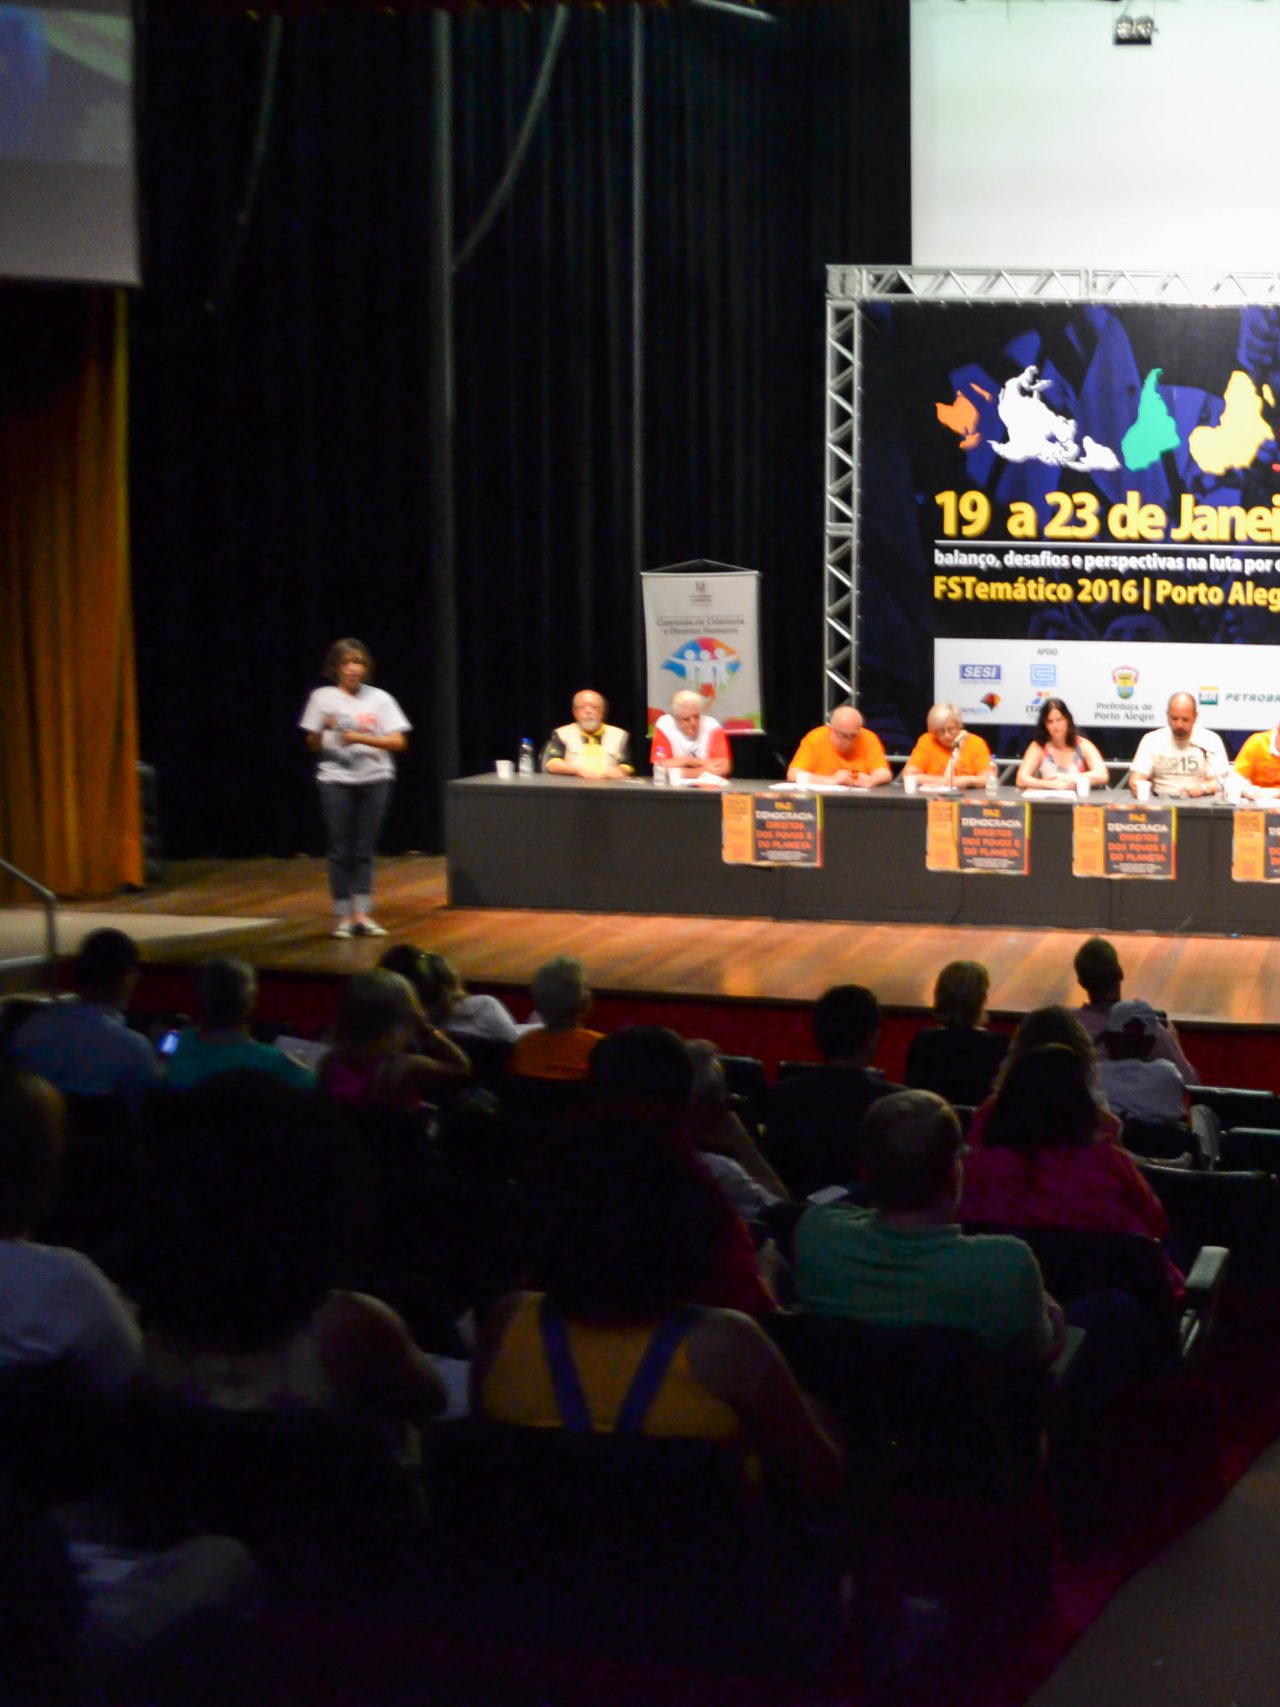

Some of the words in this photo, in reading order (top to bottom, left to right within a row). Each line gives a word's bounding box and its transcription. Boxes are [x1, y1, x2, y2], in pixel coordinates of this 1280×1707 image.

[935, 490, 991, 538] 19
[1006, 501, 1038, 539] a
[1043, 491, 1101, 540] 23
[1107, 490, 1167, 541] de
[934, 549, 1002, 571] balanço,
[1003, 549, 1070, 570] desafios
[1071, 555, 1083, 569] e
[1084, 552, 1184, 573] perspectivas
[1187, 557, 1208, 572] na
[1209, 554, 1241, 573] luta
[1244, 557, 1274, 576] por
[933, 575, 1074, 602] FSTemático
[1076, 578, 1139, 603] 2016
[1156, 579, 1224, 605] Porto
[964, 665, 997, 679] SESI
[1094, 711, 1120, 721] Porto
[1123, 711, 1155, 722] Alegre
[1181, 755, 1199, 772] 15
[755, 810, 815, 820] DEMOCRACIA
[961, 817, 1022, 828] DEMOCRACIA
[1107, 822, 1168, 832] DEMOCRACIA
